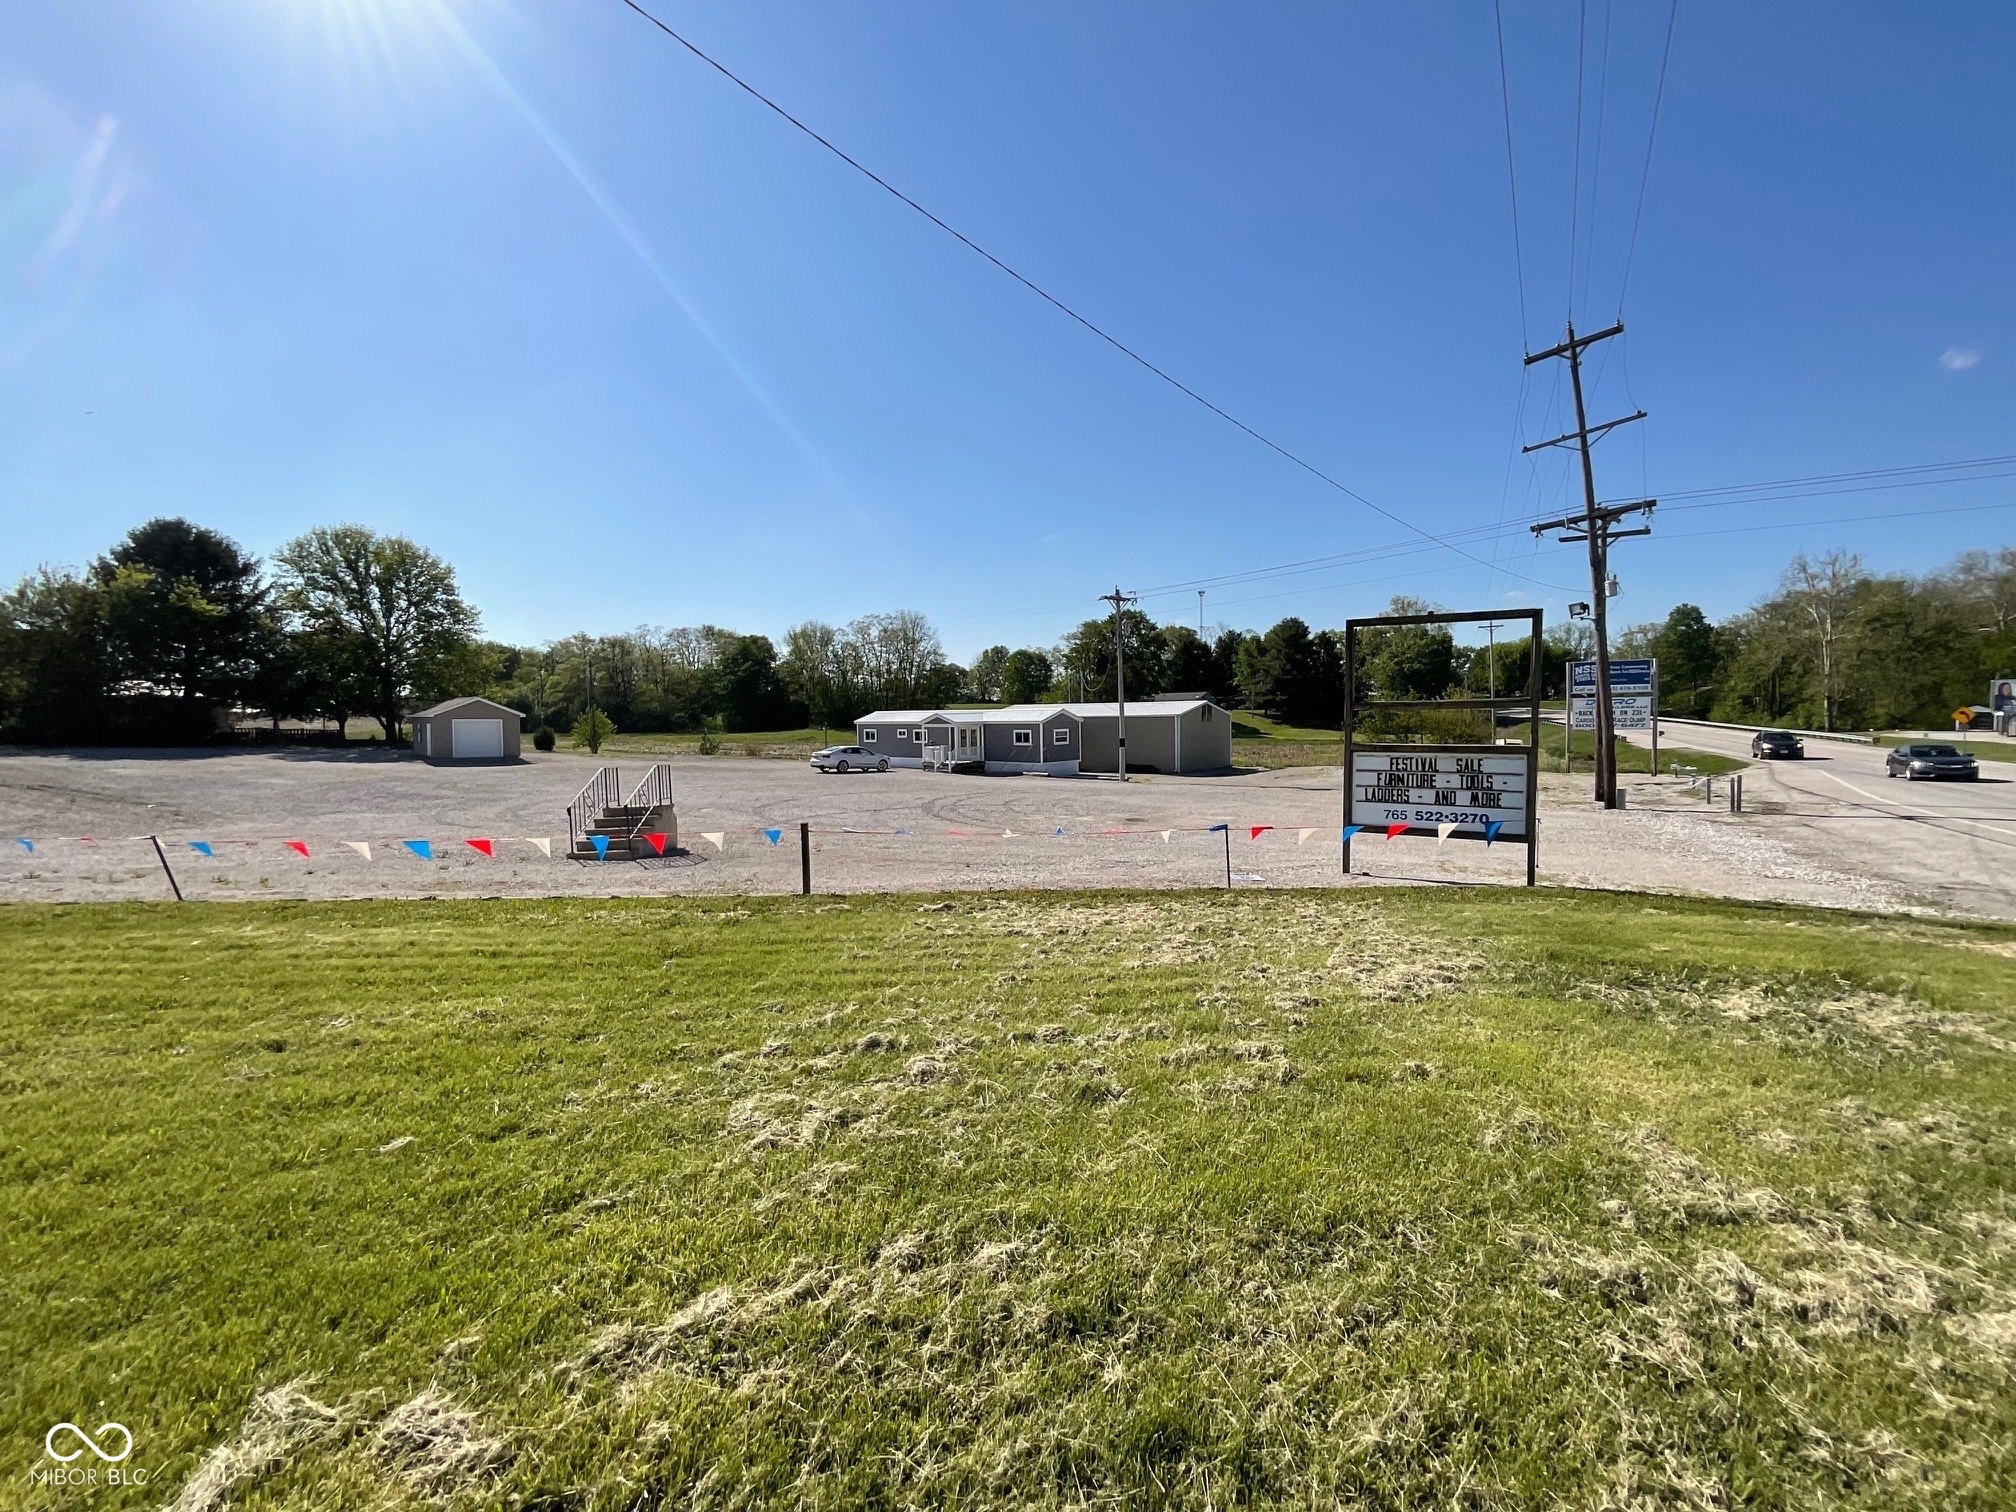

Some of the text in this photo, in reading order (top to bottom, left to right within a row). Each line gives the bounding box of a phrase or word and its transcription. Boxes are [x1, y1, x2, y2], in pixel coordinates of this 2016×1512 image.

[1389, 757, 1484, 773] FESTIVAL SALE
[1377, 772, 1437, 788] FURNITURE
[1459, 774, 1493, 790] TOOLS
[1364, 788, 1410, 803] LADDERS
[1434, 790, 1457, 806] AND
[1470, 792, 1503, 808] MORE
[1383, 809, 1408, 821] 765
